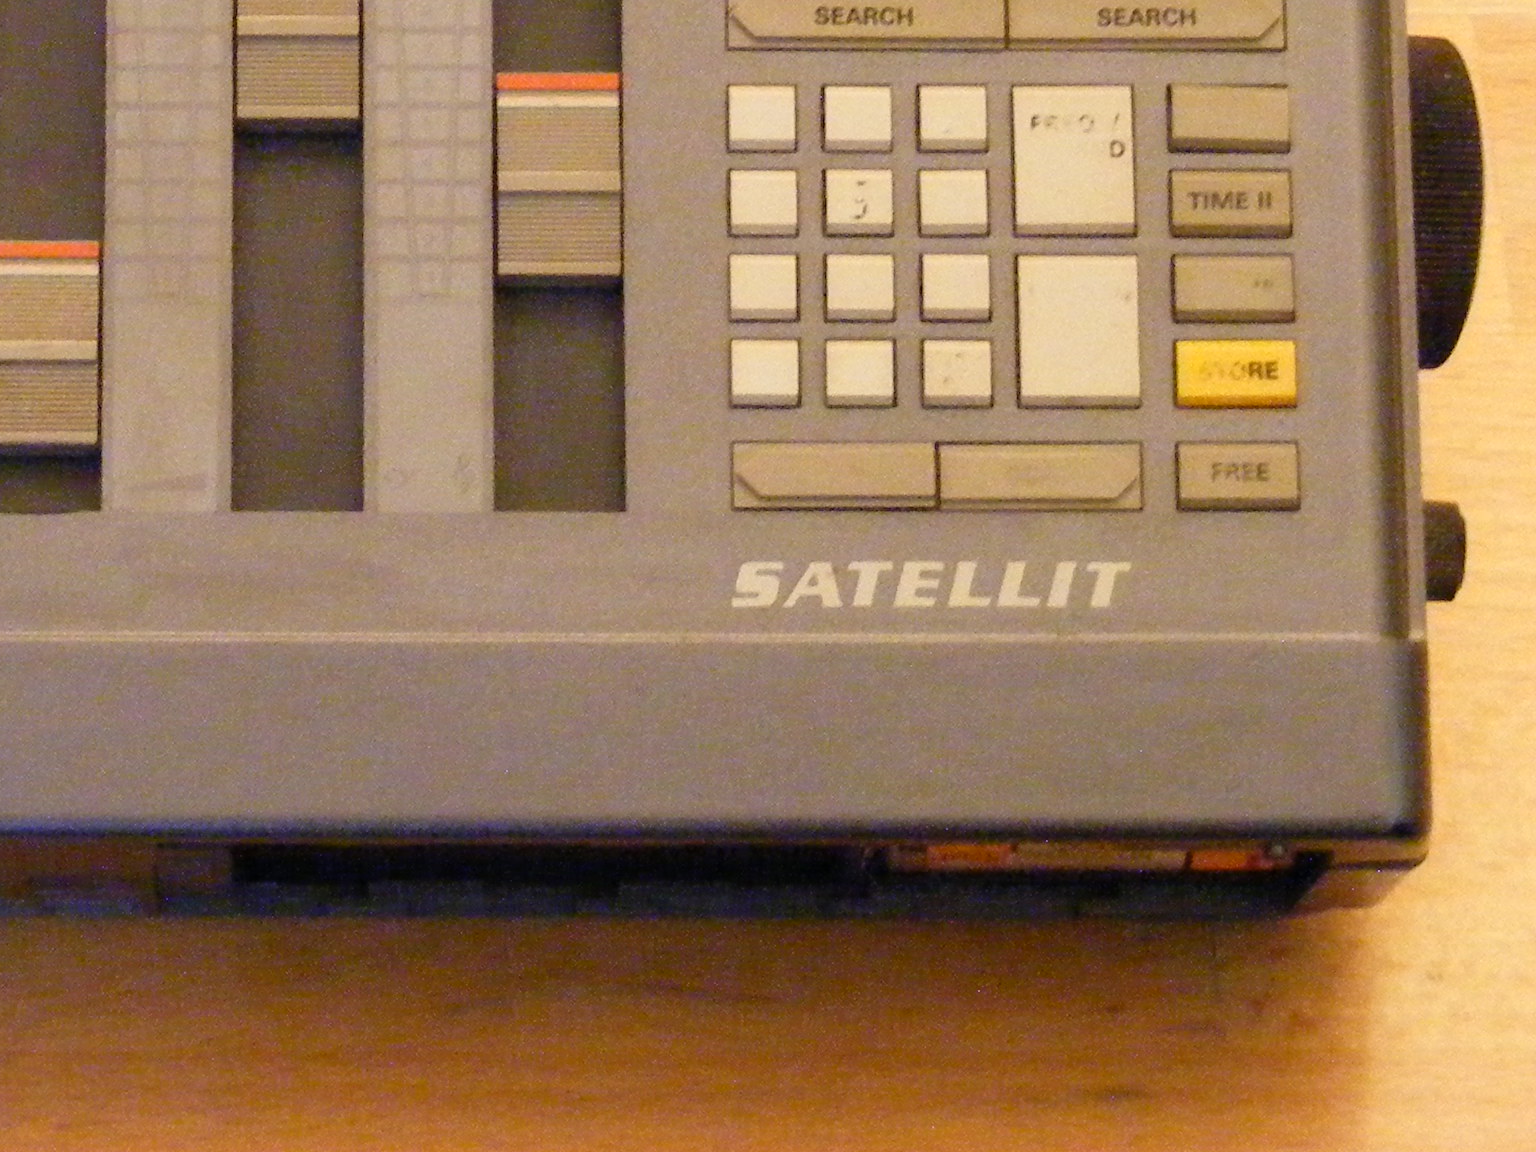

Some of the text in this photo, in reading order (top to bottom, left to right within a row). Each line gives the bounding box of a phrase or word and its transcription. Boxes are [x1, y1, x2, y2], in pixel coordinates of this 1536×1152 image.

[813, 6, 916, 28] SEARCH
[1096, 7, 1198, 29] SEARCH
[1186, 191, 1251, 212] TIME
[1210, 462, 1272, 484] FREE
[731, 560, 1134, 609] SATELLIT
